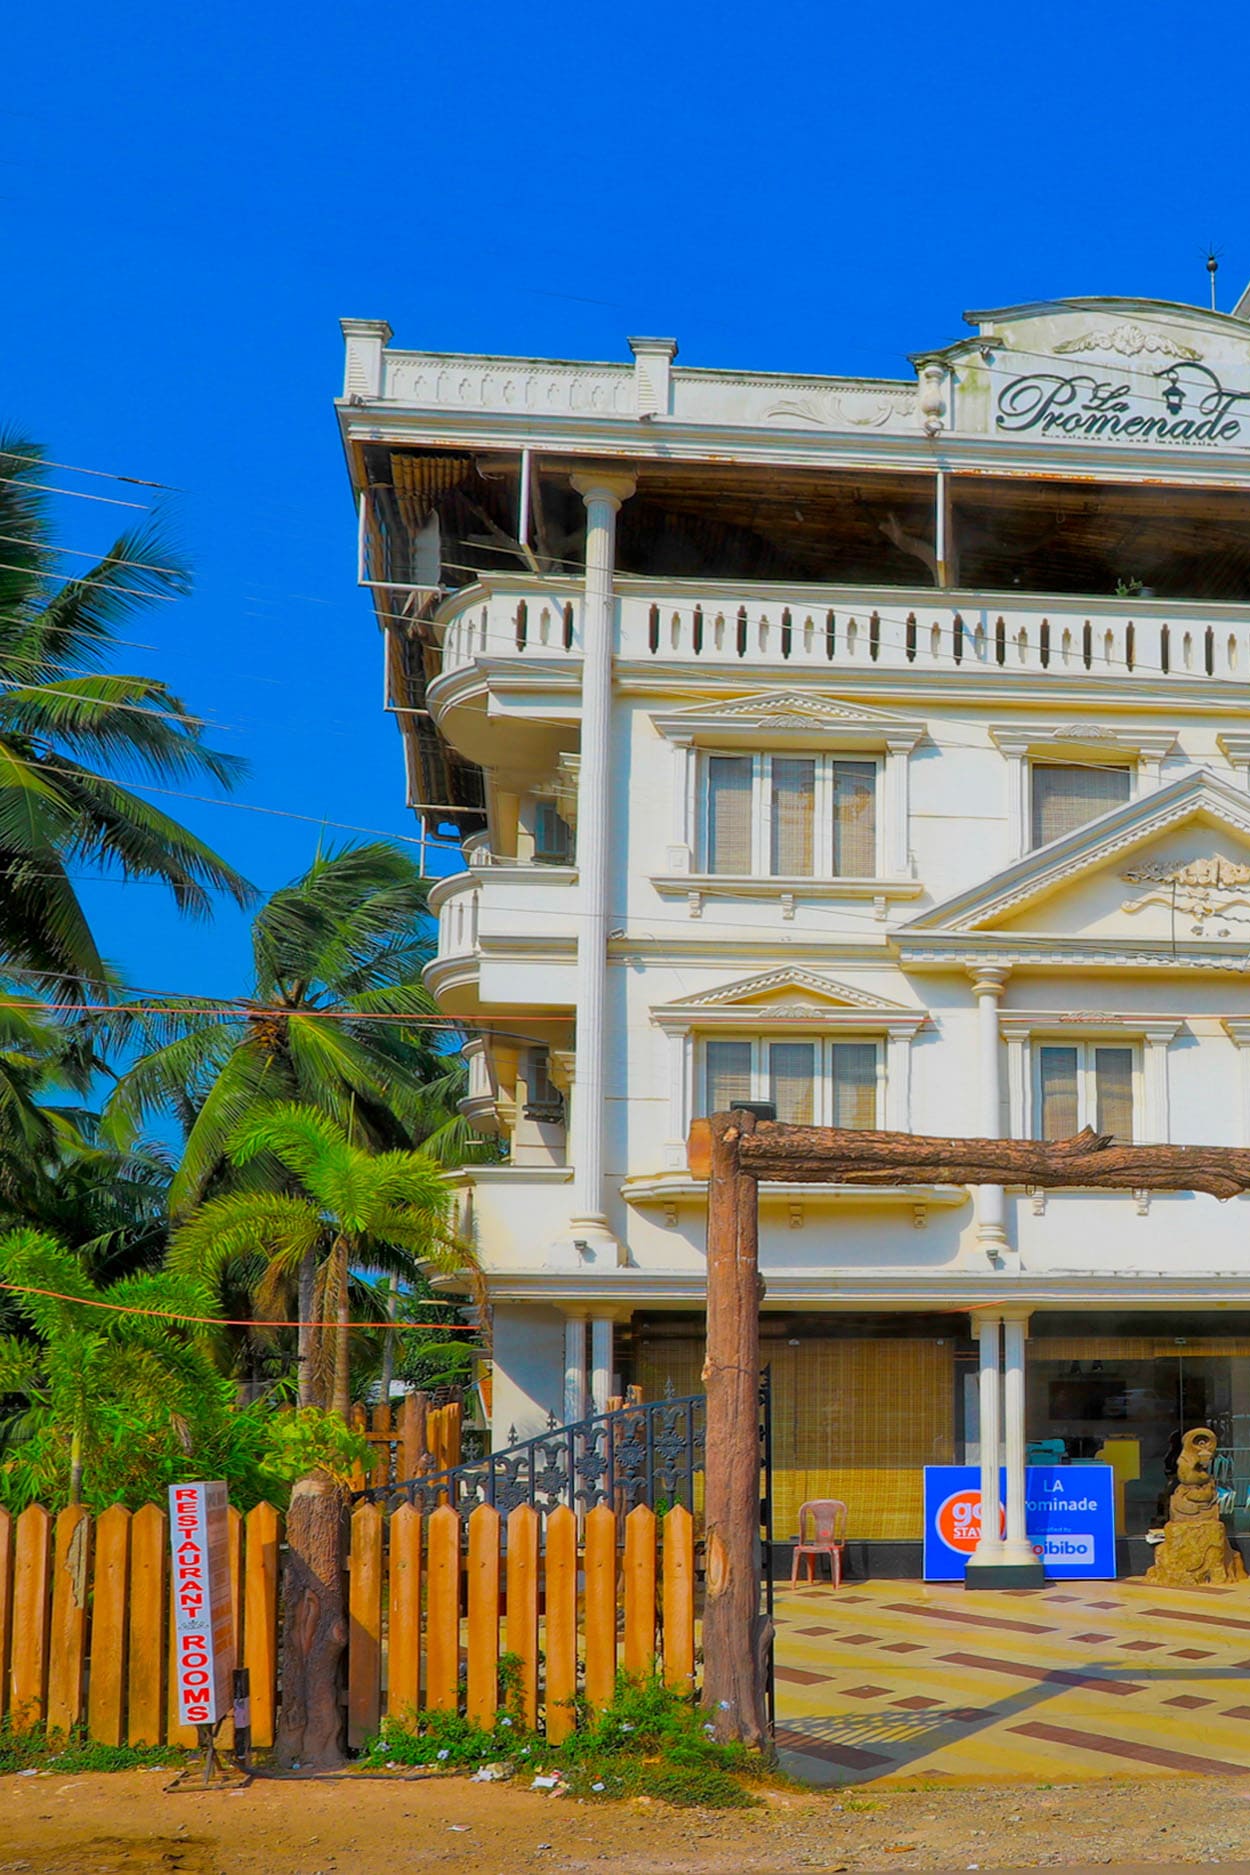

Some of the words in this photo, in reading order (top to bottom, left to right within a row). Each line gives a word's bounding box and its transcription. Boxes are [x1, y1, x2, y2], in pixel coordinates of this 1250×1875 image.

[1081, 382, 1131, 413] La
[1043, 1479, 1064, 1492] LA
[1025, 1497, 1097, 1512] ominade
[175, 1489, 203, 1618] RESTAURANT
[1031, 1541, 1088, 1555] oibibo
[181, 1635, 210, 1722] ROOMS
